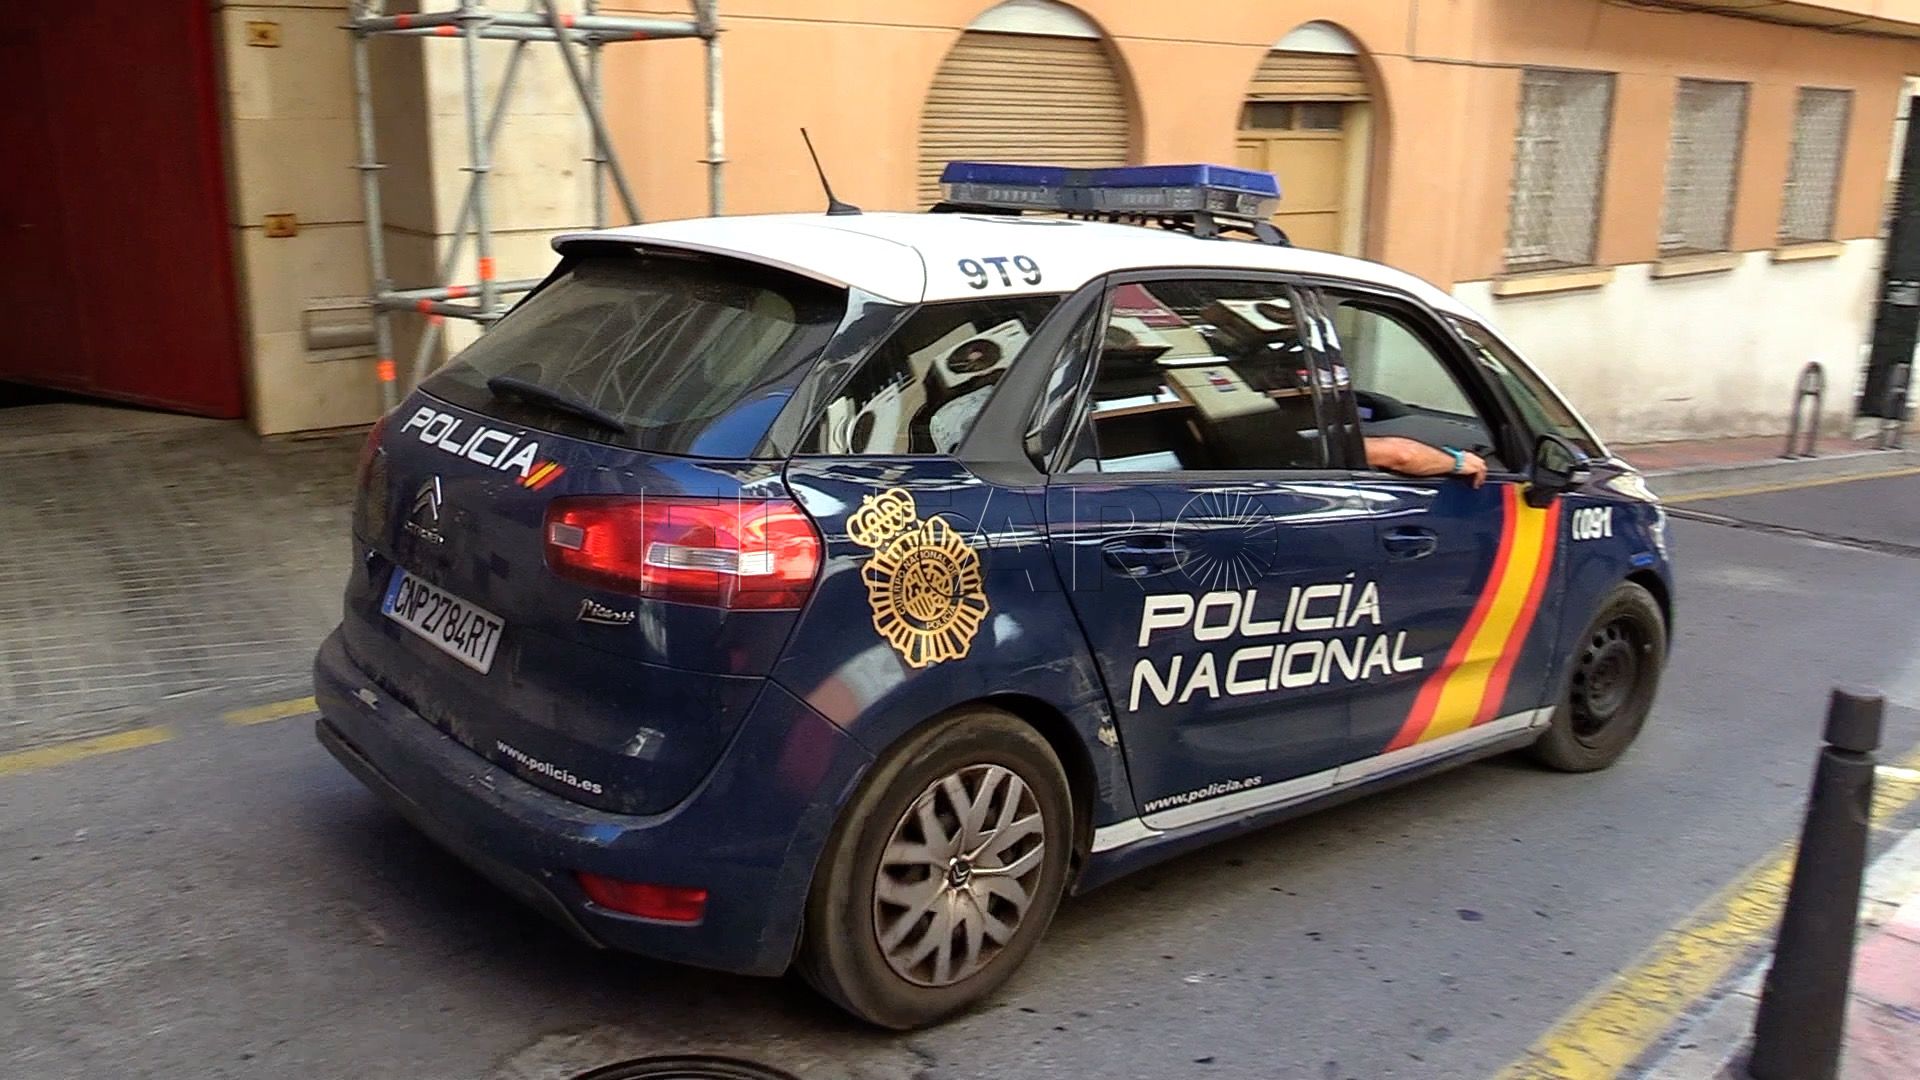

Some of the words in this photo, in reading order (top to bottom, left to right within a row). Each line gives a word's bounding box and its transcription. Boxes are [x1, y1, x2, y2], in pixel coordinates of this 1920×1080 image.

[958, 255, 1042, 290] 9T9
[401, 406, 539, 478] POLICÍA
[903, 550, 950, 570] NACIONAL
[394, 577, 500, 663] CNP2784RT
[1137, 572, 1382, 647] POLICÍA
[1128, 630, 1424, 712] NACIONAL
[496, 740, 603, 794] www.policia.es
[1143, 774, 1263, 814] www.policia.es
